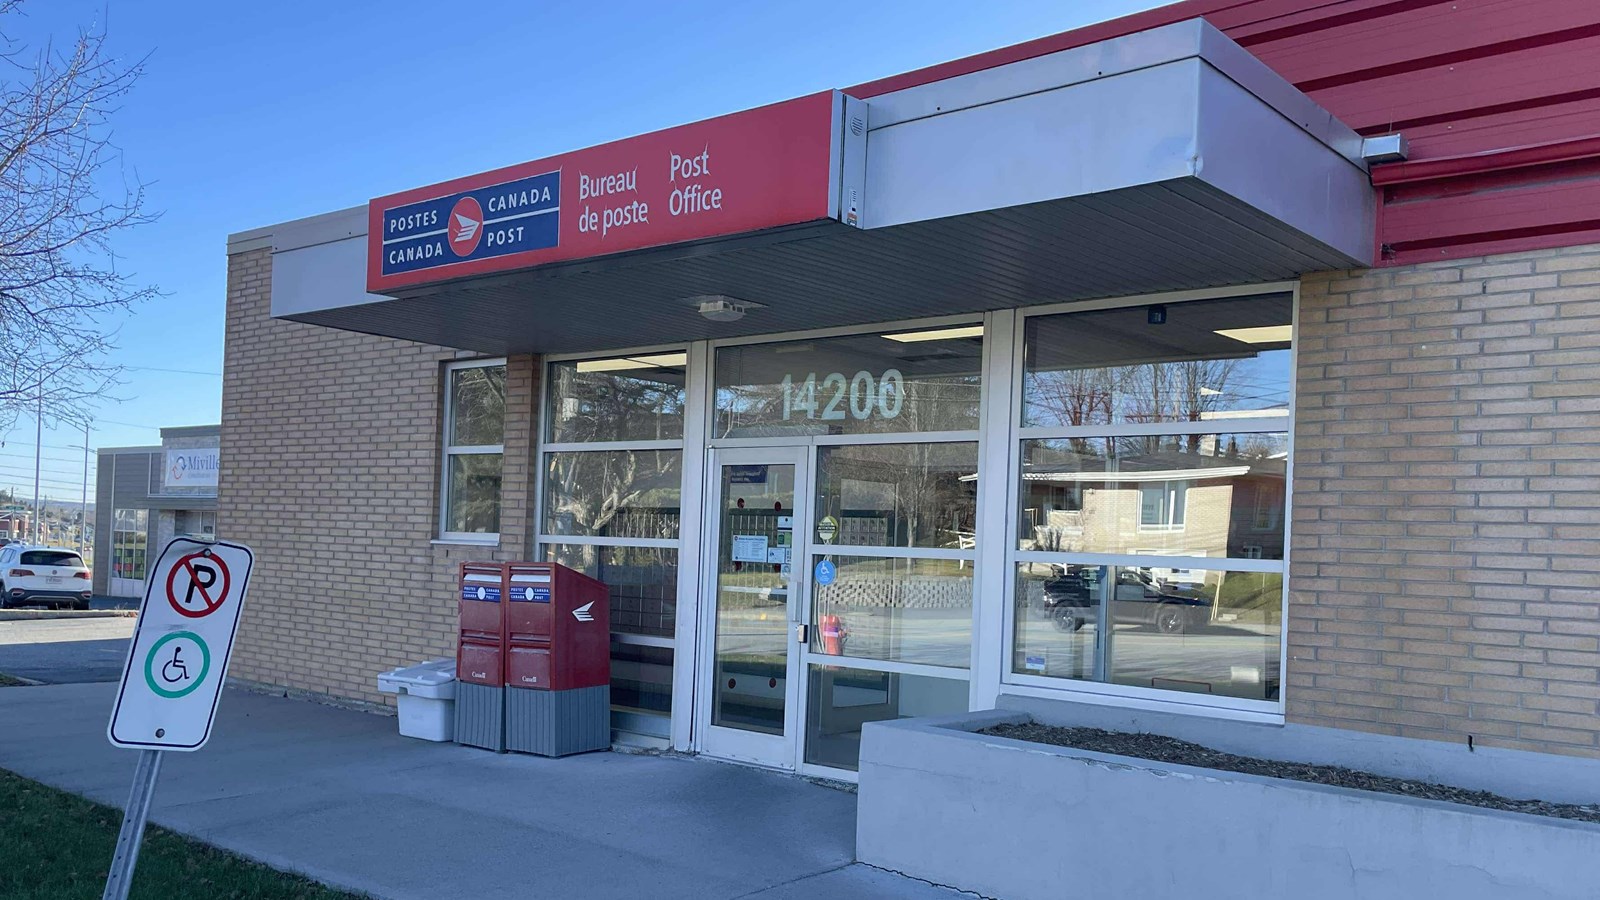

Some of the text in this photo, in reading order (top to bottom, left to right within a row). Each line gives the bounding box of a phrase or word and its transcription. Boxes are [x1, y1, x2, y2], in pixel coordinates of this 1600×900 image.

[669, 151, 709, 181] Post
[580, 170, 637, 200] Bureau
[669, 185, 722, 216] Office
[390, 186, 551, 233] POSTES CANADA
[579, 201, 648, 236] de poste
[389, 227, 524, 265] CANADA POST
[780, 368, 904, 421] 14200
[184, 564, 217, 604] P
